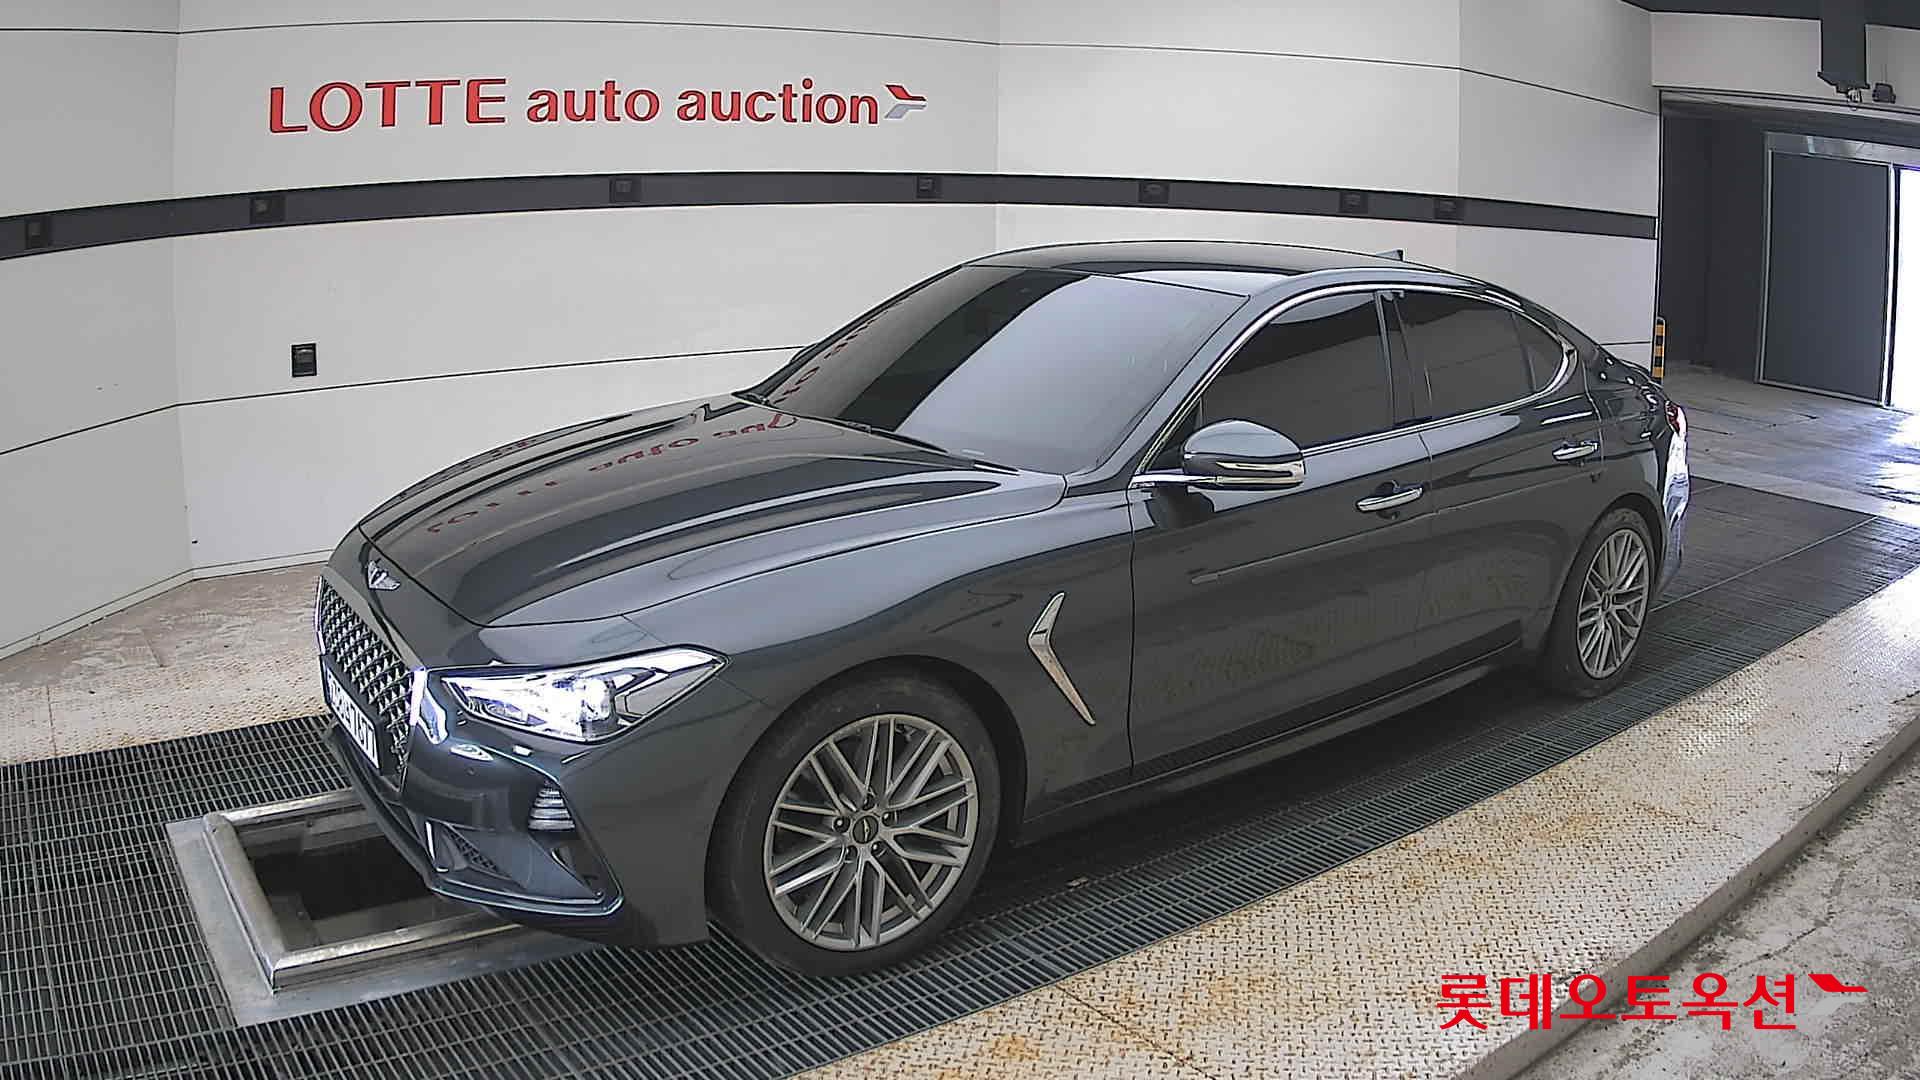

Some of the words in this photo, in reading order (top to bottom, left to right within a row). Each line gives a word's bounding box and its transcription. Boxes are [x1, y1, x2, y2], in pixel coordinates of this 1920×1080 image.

[269, 78, 506, 134] LOTTE
[526, 80, 661, 123] auto
[675, 78, 880, 125] auction
